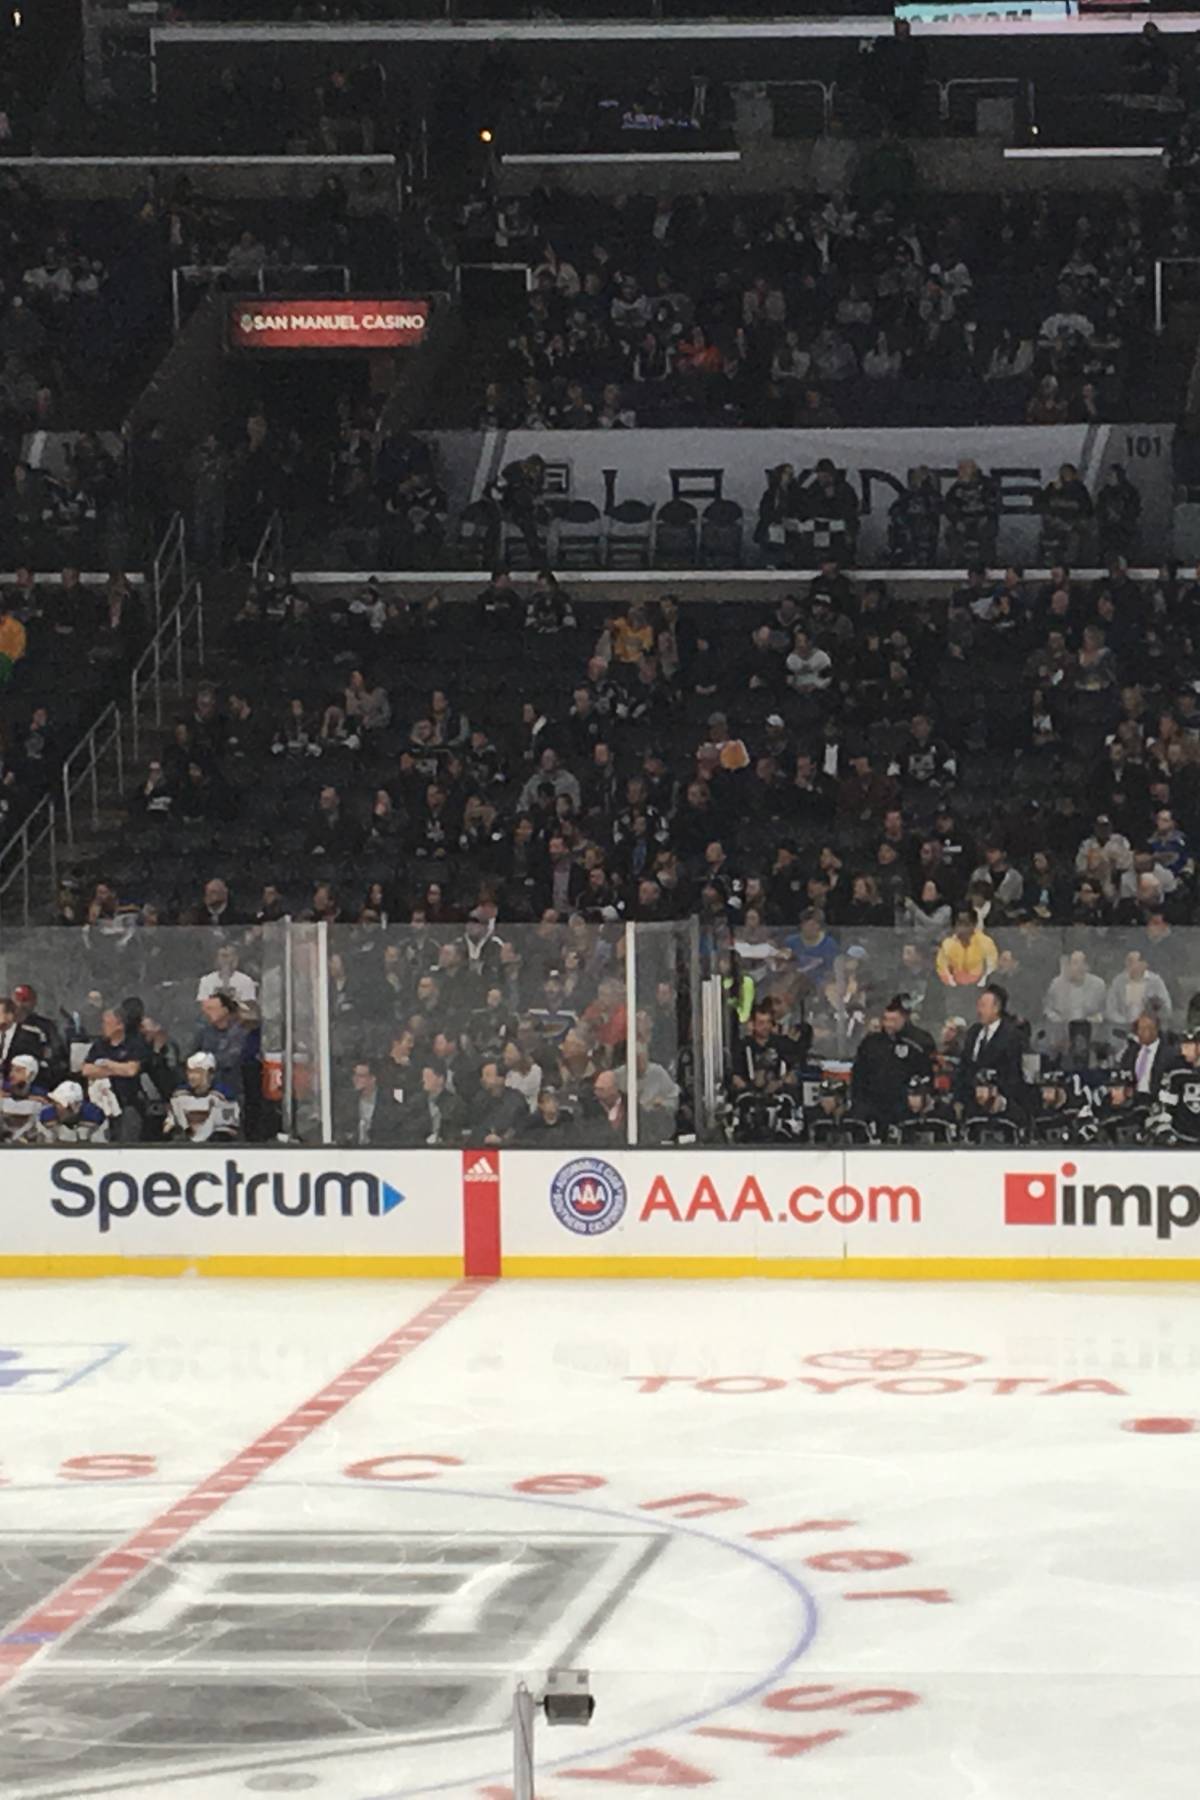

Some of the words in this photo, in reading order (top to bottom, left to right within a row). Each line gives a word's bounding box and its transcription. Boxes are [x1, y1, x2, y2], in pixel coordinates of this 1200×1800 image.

[254, 314, 288, 330] SAN
[291, 314, 359, 330] MANUEL
[362, 314, 424, 330] CASINO
[1126, 436, 1161, 457] 101
[50, 1158, 380, 1233] Spectrum
[571, 1183, 606, 1205] AAA
[639, 1174, 921, 1223] AAA.com
[621, 1375, 1131, 1395] TOYOTA
